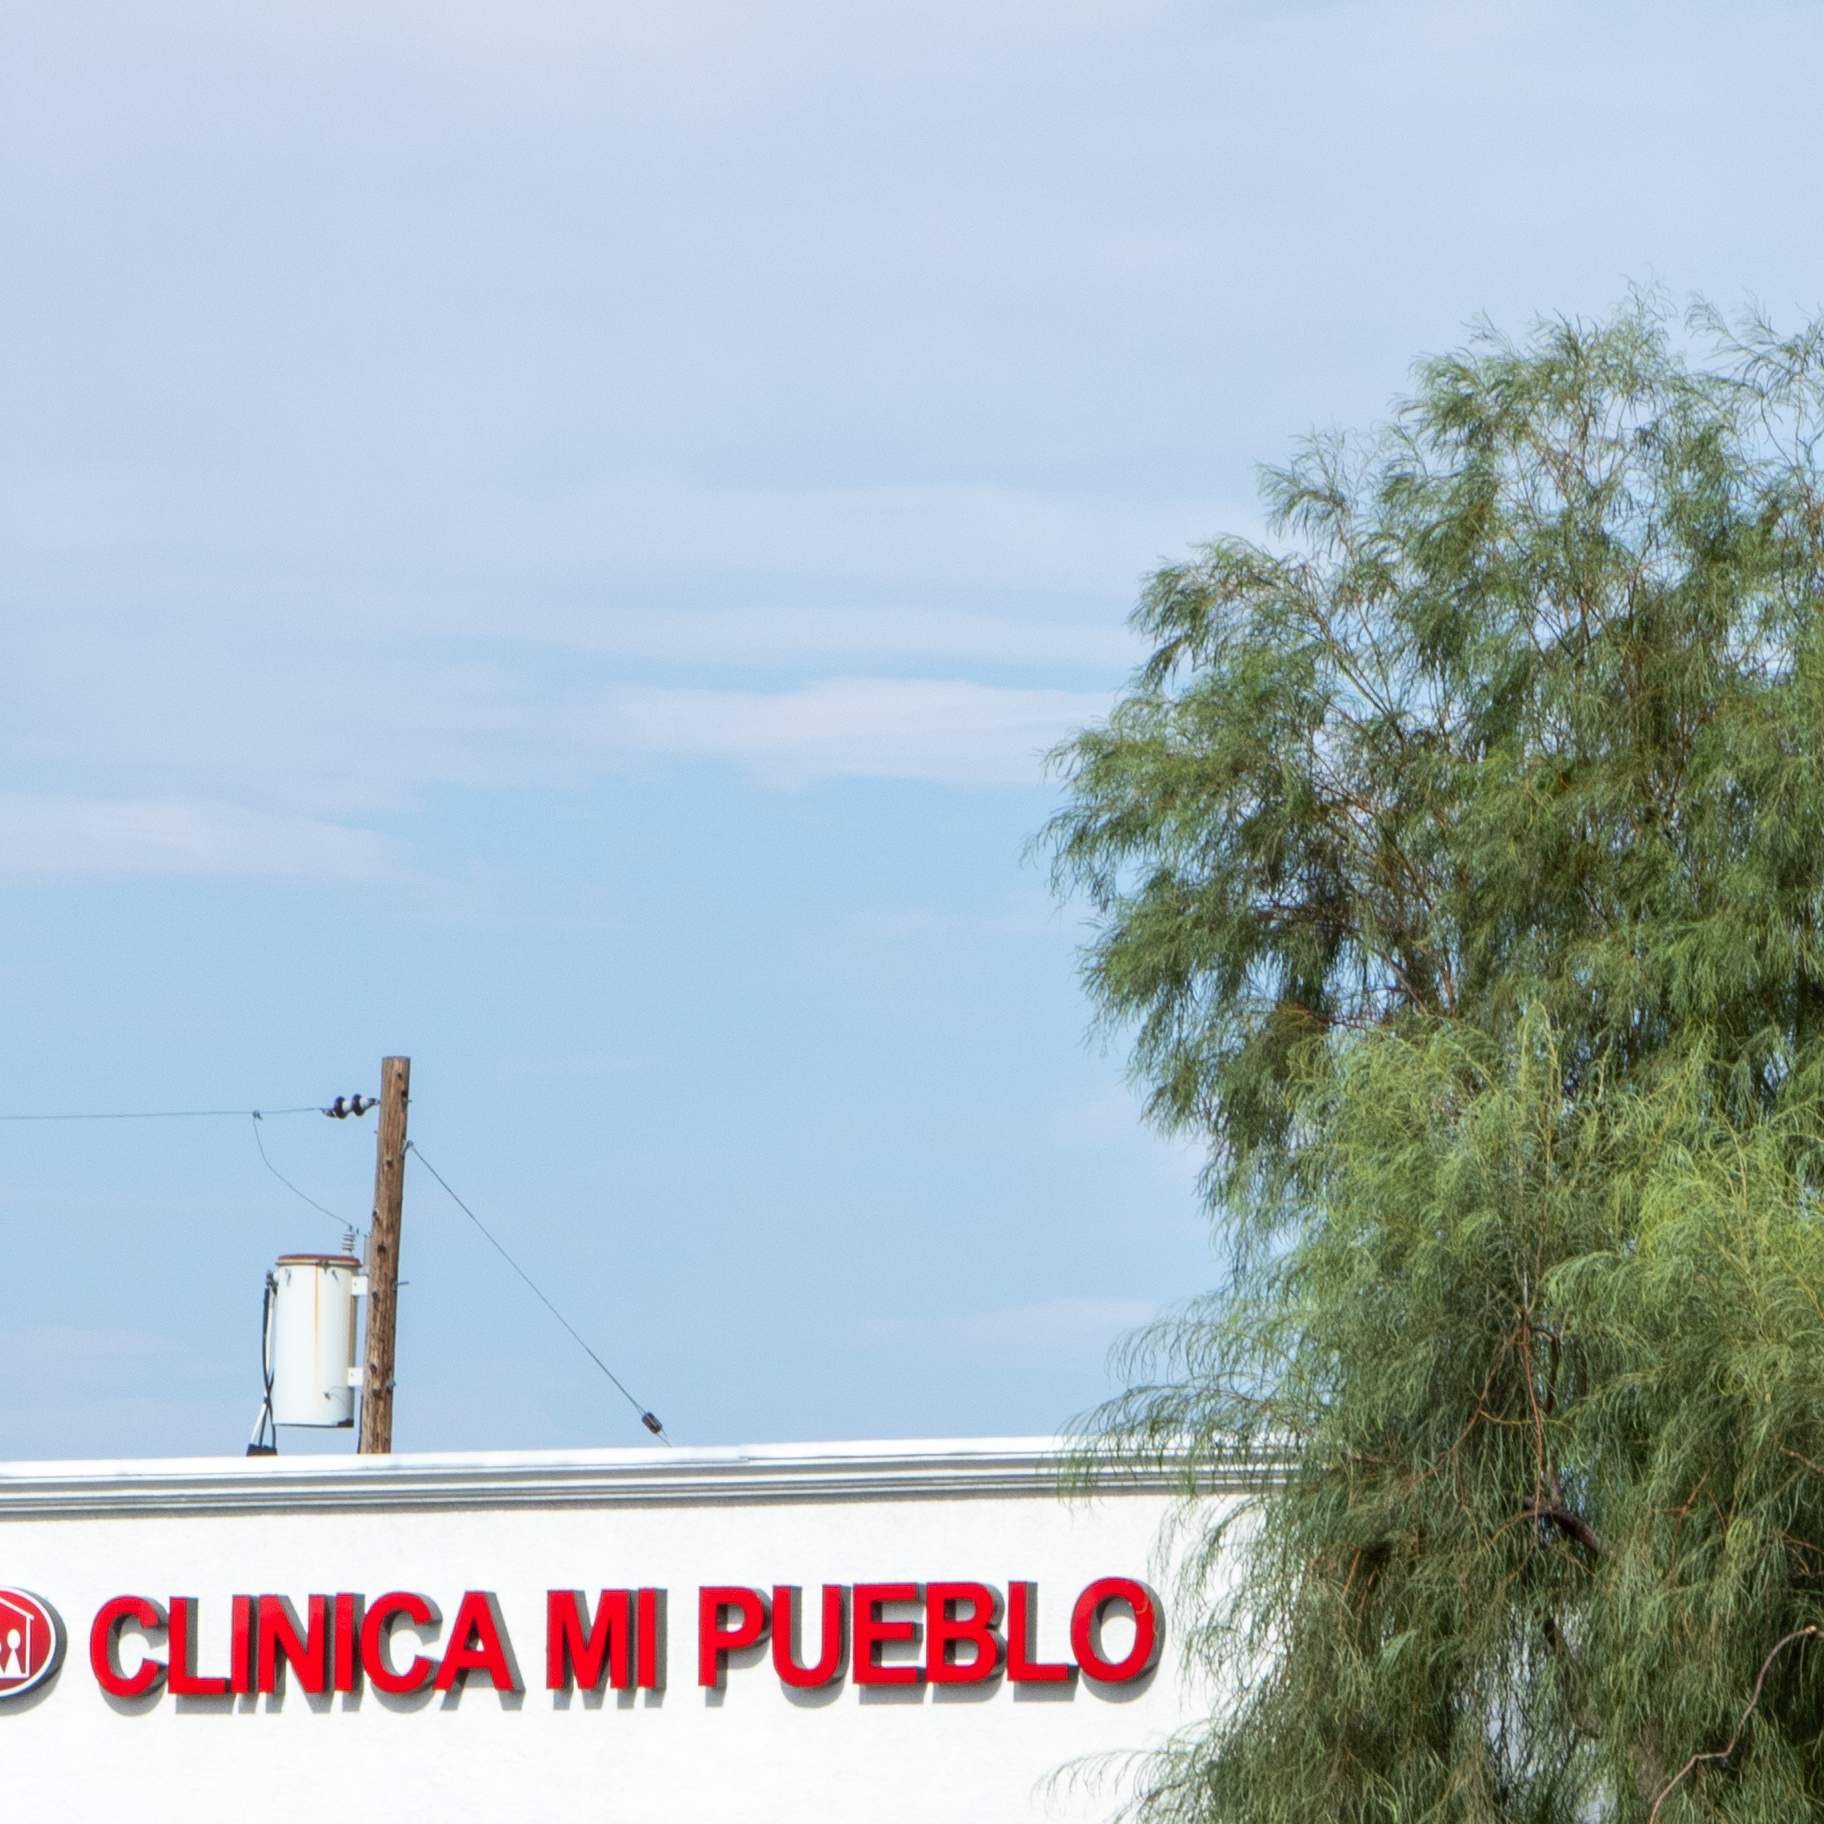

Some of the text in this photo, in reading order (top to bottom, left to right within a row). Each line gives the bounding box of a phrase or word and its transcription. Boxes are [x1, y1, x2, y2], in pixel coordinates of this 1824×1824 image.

[90, 1577, 1158, 1697] CLINICA MI PUEBLO
